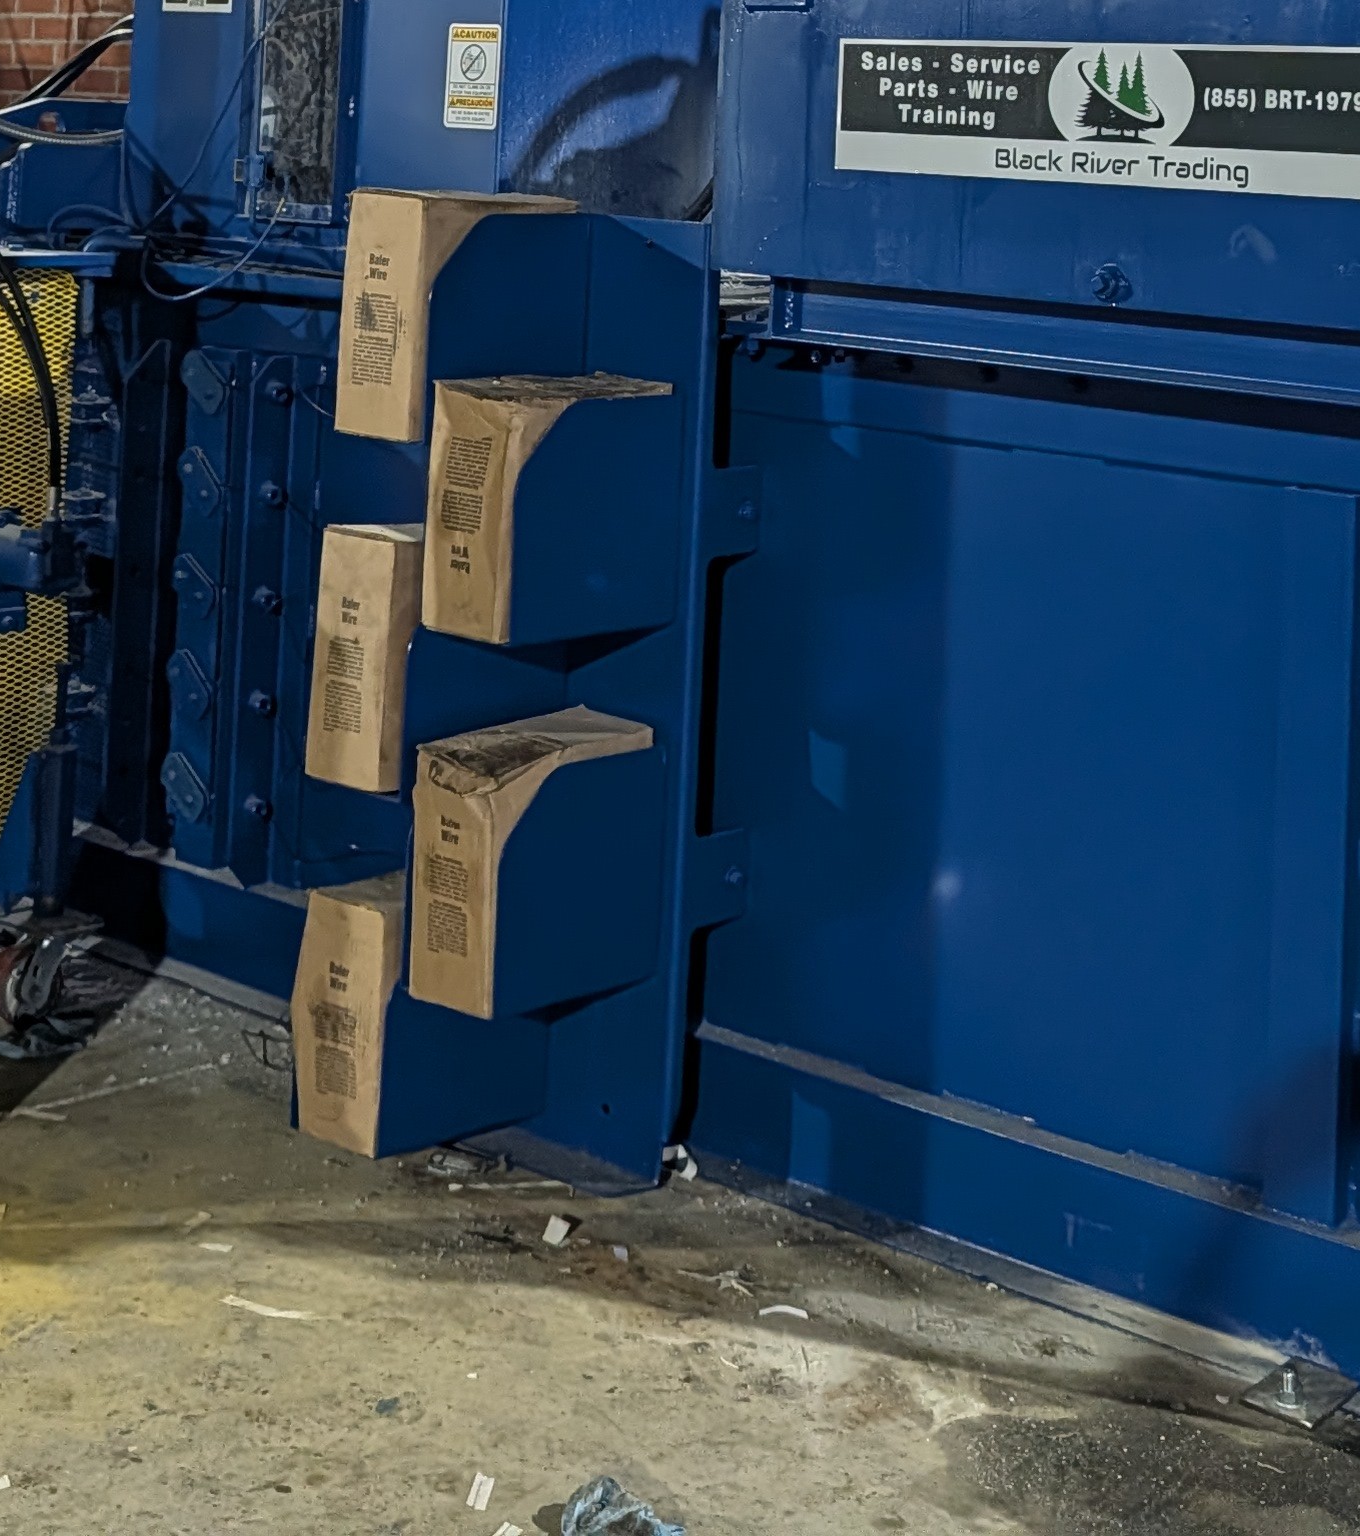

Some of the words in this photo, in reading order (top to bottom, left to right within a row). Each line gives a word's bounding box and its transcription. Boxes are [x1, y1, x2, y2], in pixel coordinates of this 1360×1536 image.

[459, 29, 497, 39] CAUTION
[861, 50, 923, 72] Sales
[950, 52, 1041, 75] Service
[879, 76, 939, 98] Parts
[966, 79, 1019, 101] Wire
[1203, 86, 1257, 113] (855)
[898, 103, 996, 131] Training
[995, 147, 1064, 172] Black
[1071, 151, 1140, 176] River
[1147, 155, 1249, 189] Trading
[369, 253, 390, 266] Baler
[369, 267, 387, 280] Wire
[341, 596, 360, 611] Baler
[341, 611, 358, 625] Wire
